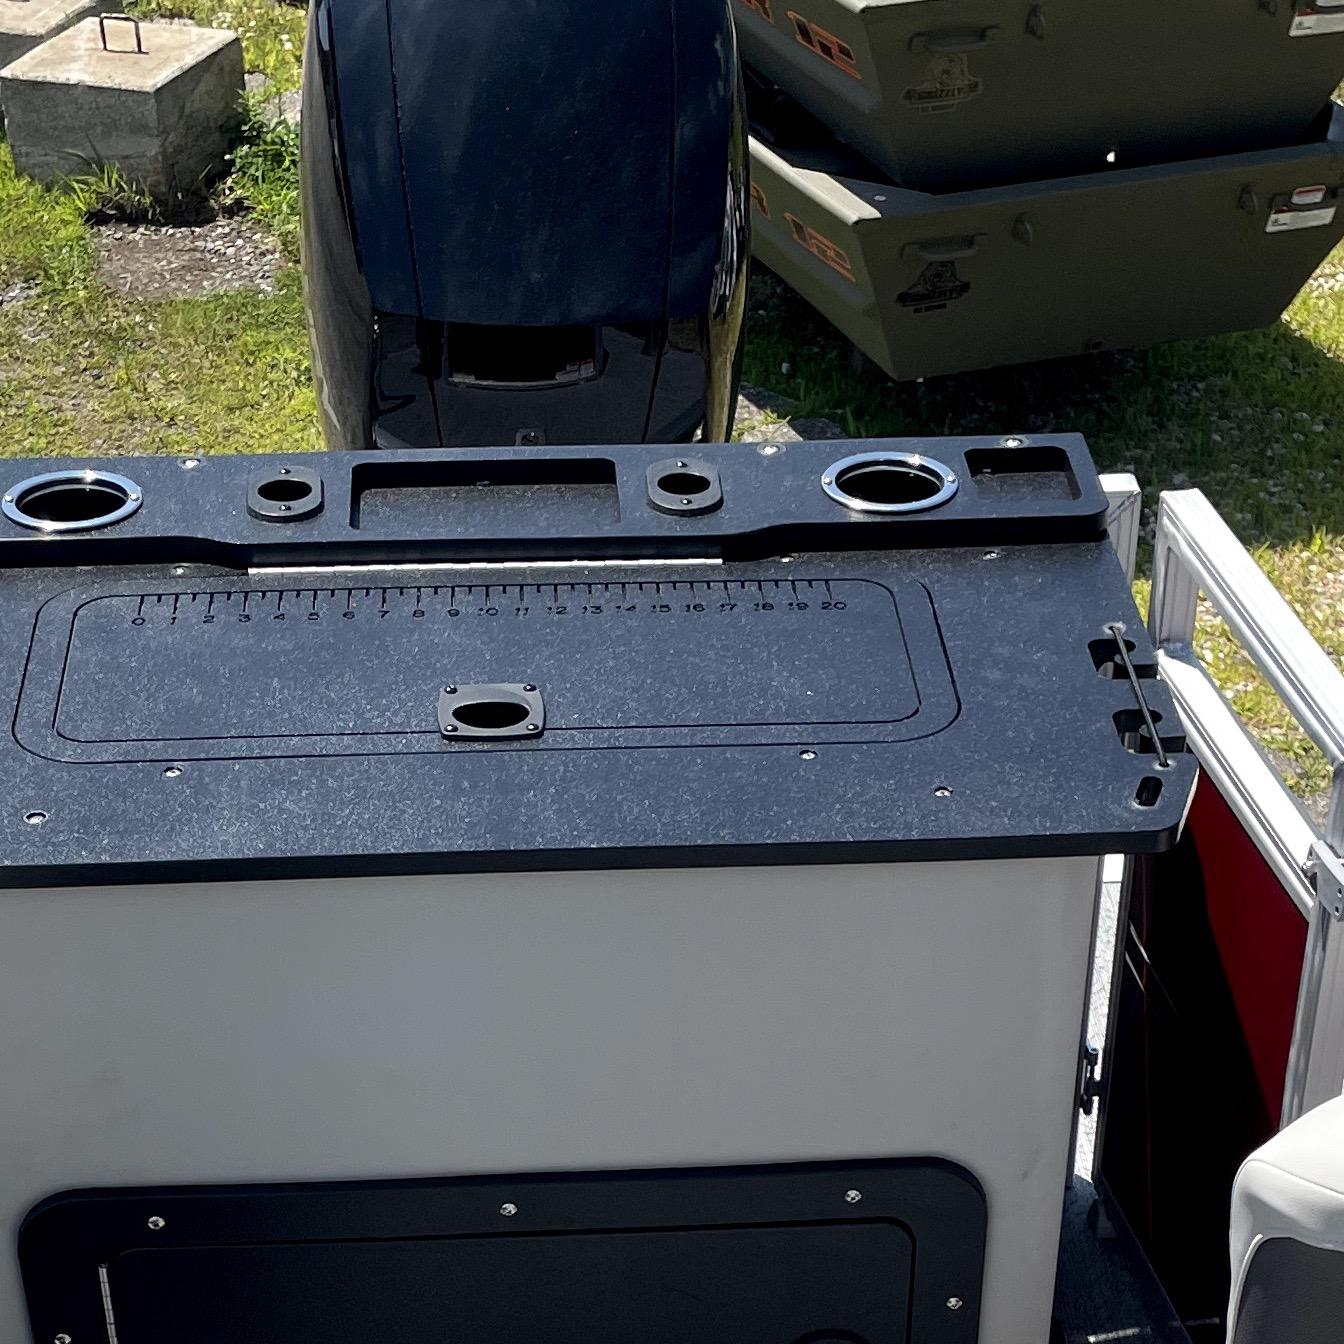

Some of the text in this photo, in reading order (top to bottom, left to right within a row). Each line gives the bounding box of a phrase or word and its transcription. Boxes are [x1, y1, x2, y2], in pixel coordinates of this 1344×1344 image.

[131, 617, 145, 626] 0
[203, 615, 215, 623] 2
[238, 614, 251, 623] 3
[273, 612, 286, 621] 4
[307, 612, 320, 620] 5
[342, 611, 355, 620] 6
[378, 610, 390, 618] 7
[412, 609, 425, 617] 8
[447, 608, 460, 617] 9
